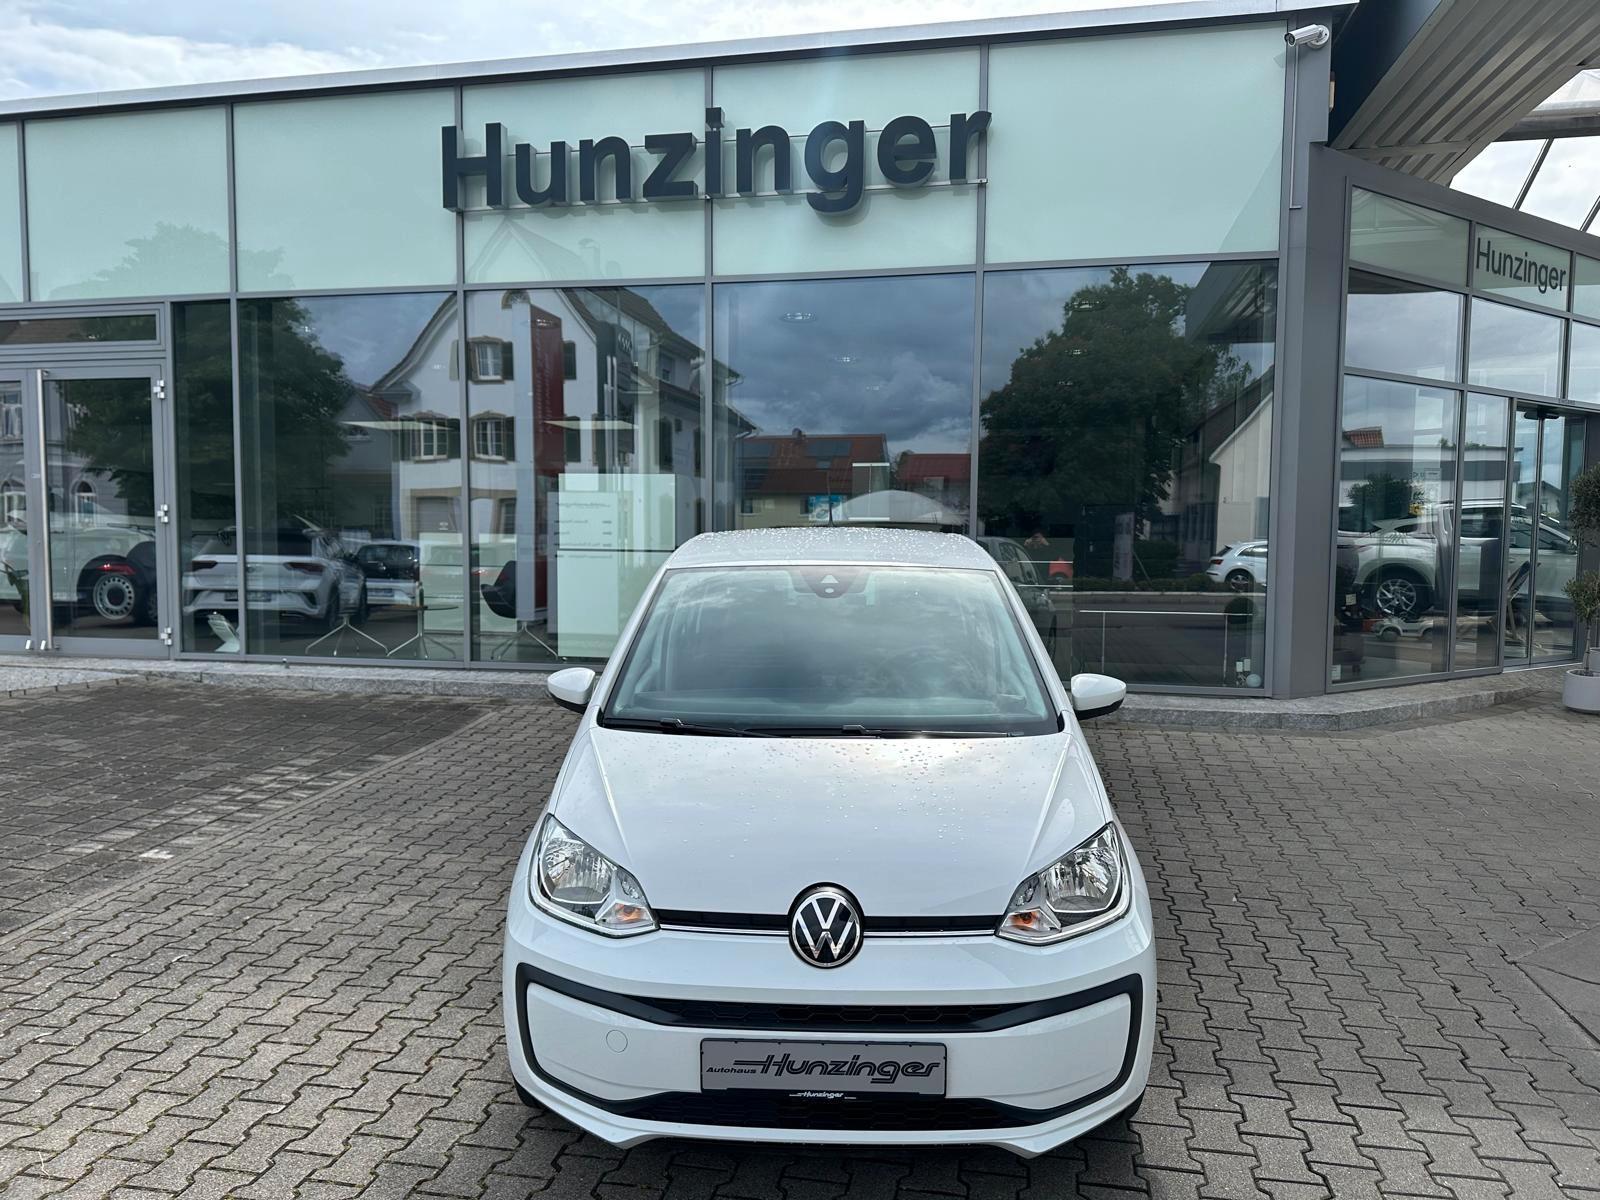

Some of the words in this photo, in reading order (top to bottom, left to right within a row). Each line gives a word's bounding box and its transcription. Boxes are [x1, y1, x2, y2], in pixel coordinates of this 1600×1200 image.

[441, 107, 992, 214] Hunzinger
[1476, 237, 1567, 294] Hunzinger
[705, 1066, 757, 1074] Autohaus
[733, 1053, 940, 1084] Hunzinger
[796, 1090, 844, 1099] Hunzinger
